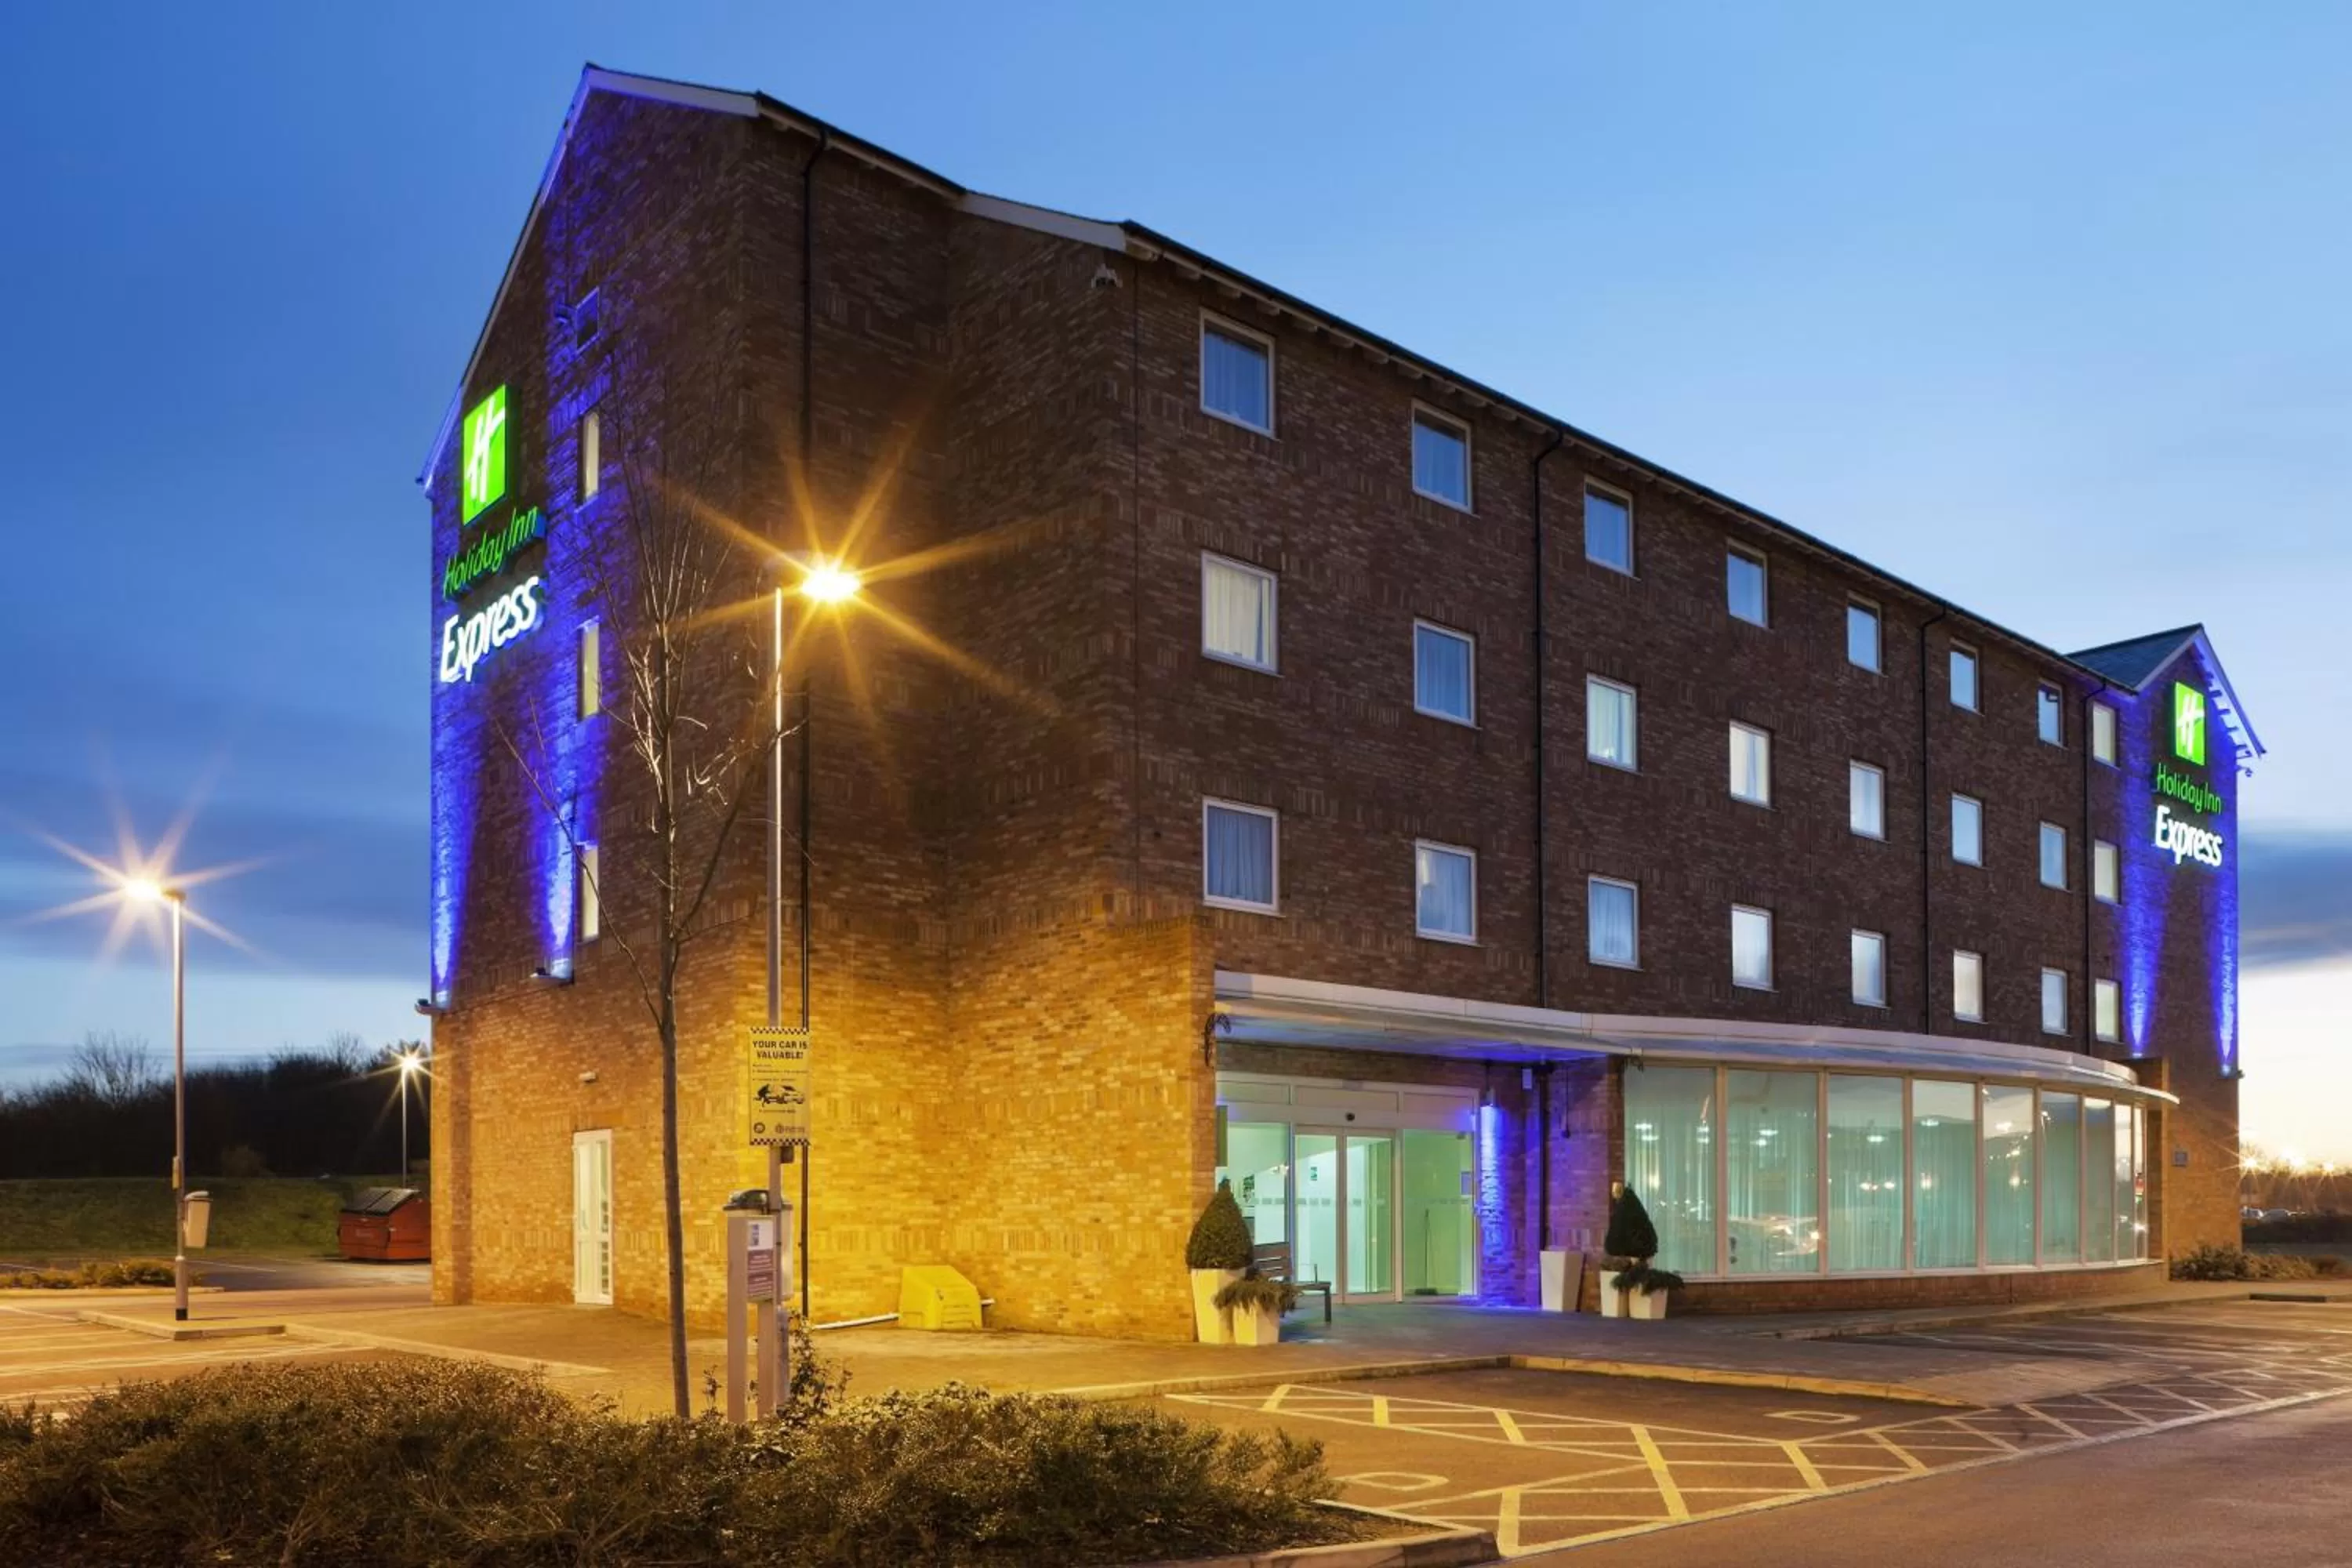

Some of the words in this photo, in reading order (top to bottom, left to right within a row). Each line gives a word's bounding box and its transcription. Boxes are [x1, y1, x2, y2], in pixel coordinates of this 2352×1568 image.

[443, 527, 507, 601] Holiday
[507, 506, 538, 551] Inn
[440, 575, 539, 683] Express
[2157, 762, 2203, 813] Holiday
[2204, 782, 2222, 815] Inn
[2155, 804, 2223, 866] Express
[779, 1040, 797, 1049] CAR
[799, 1040, 808, 1050] IS
